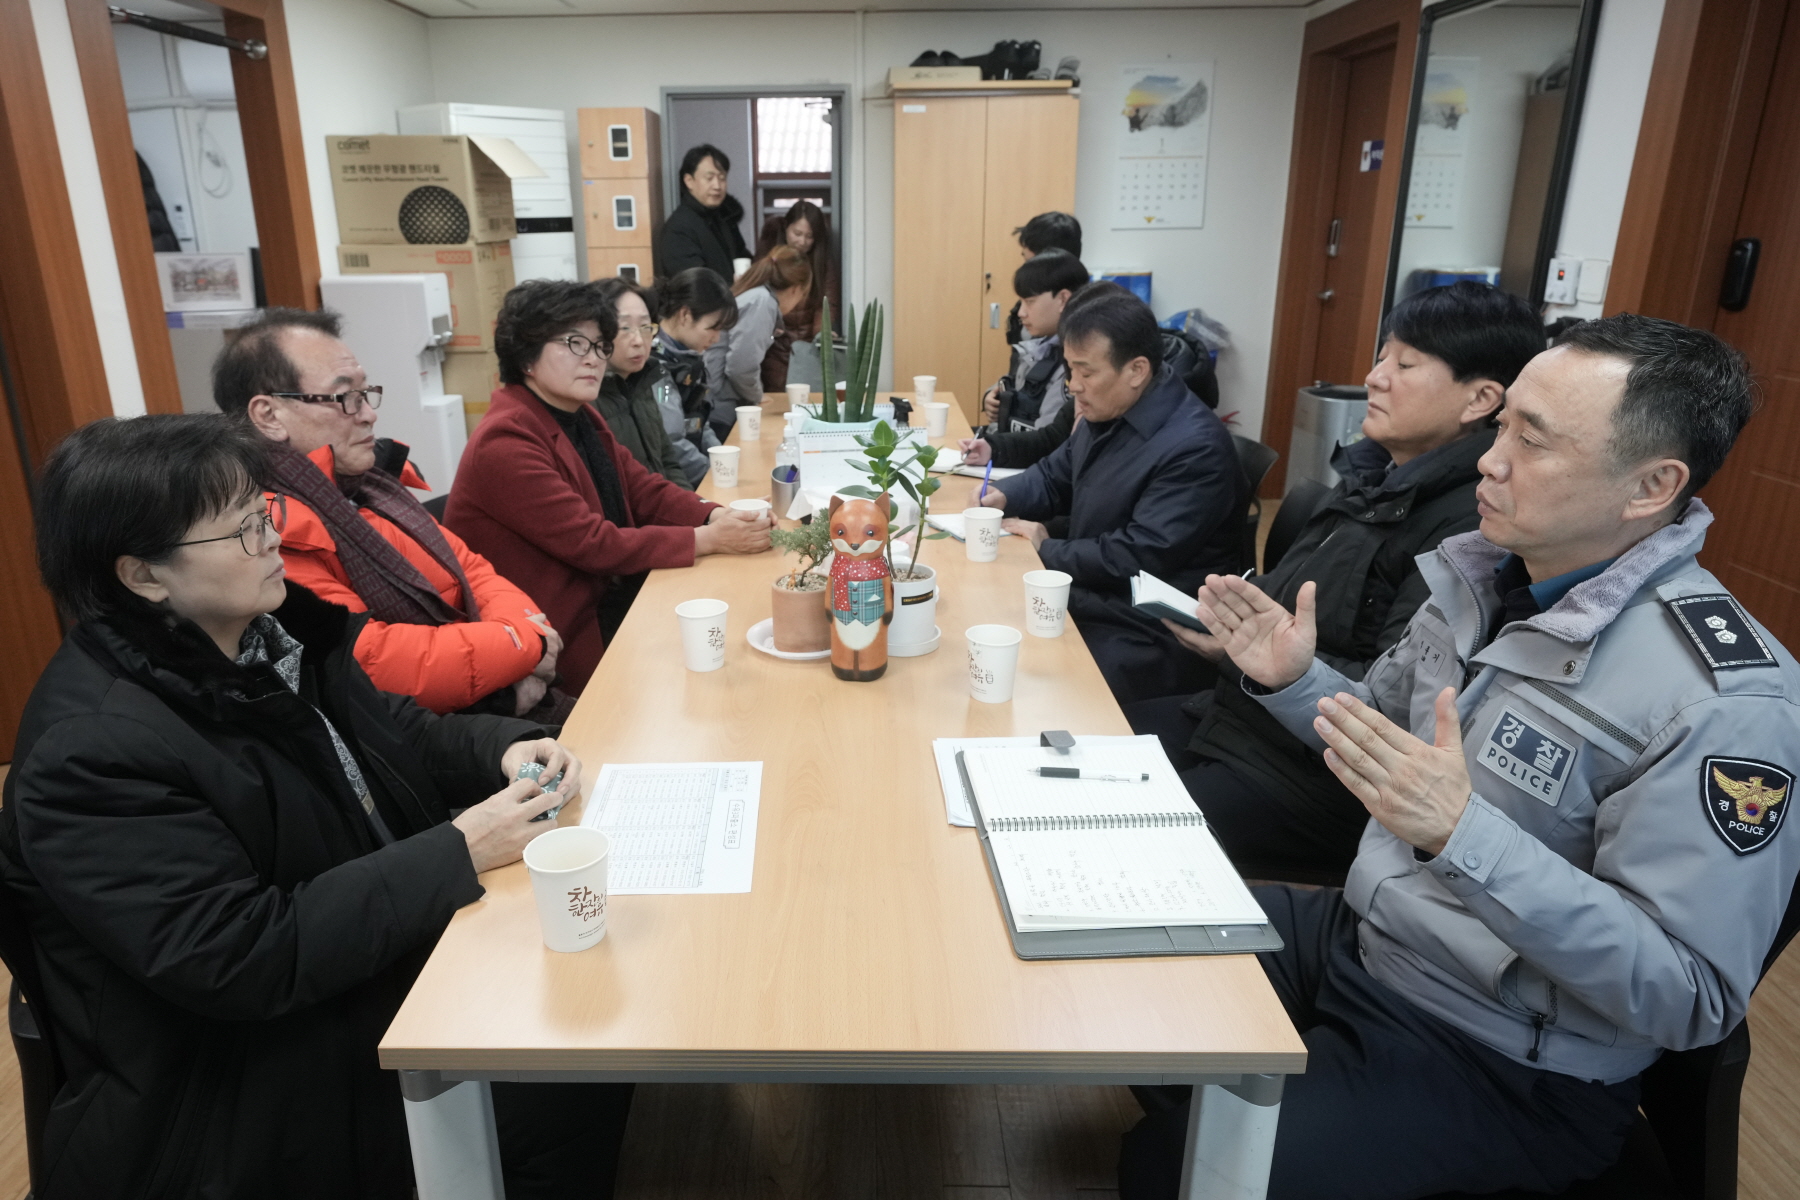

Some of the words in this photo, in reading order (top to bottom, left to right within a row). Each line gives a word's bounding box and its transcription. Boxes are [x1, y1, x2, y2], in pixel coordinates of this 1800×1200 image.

[337, 137, 370, 150] comet
[1032, 596, 1046, 607] 차
[707, 627, 721, 638] 차
[1487, 747, 1553, 795] POLICE
[1728, 820, 1766, 836] POLICE
[567, 886, 593, 903] 차
